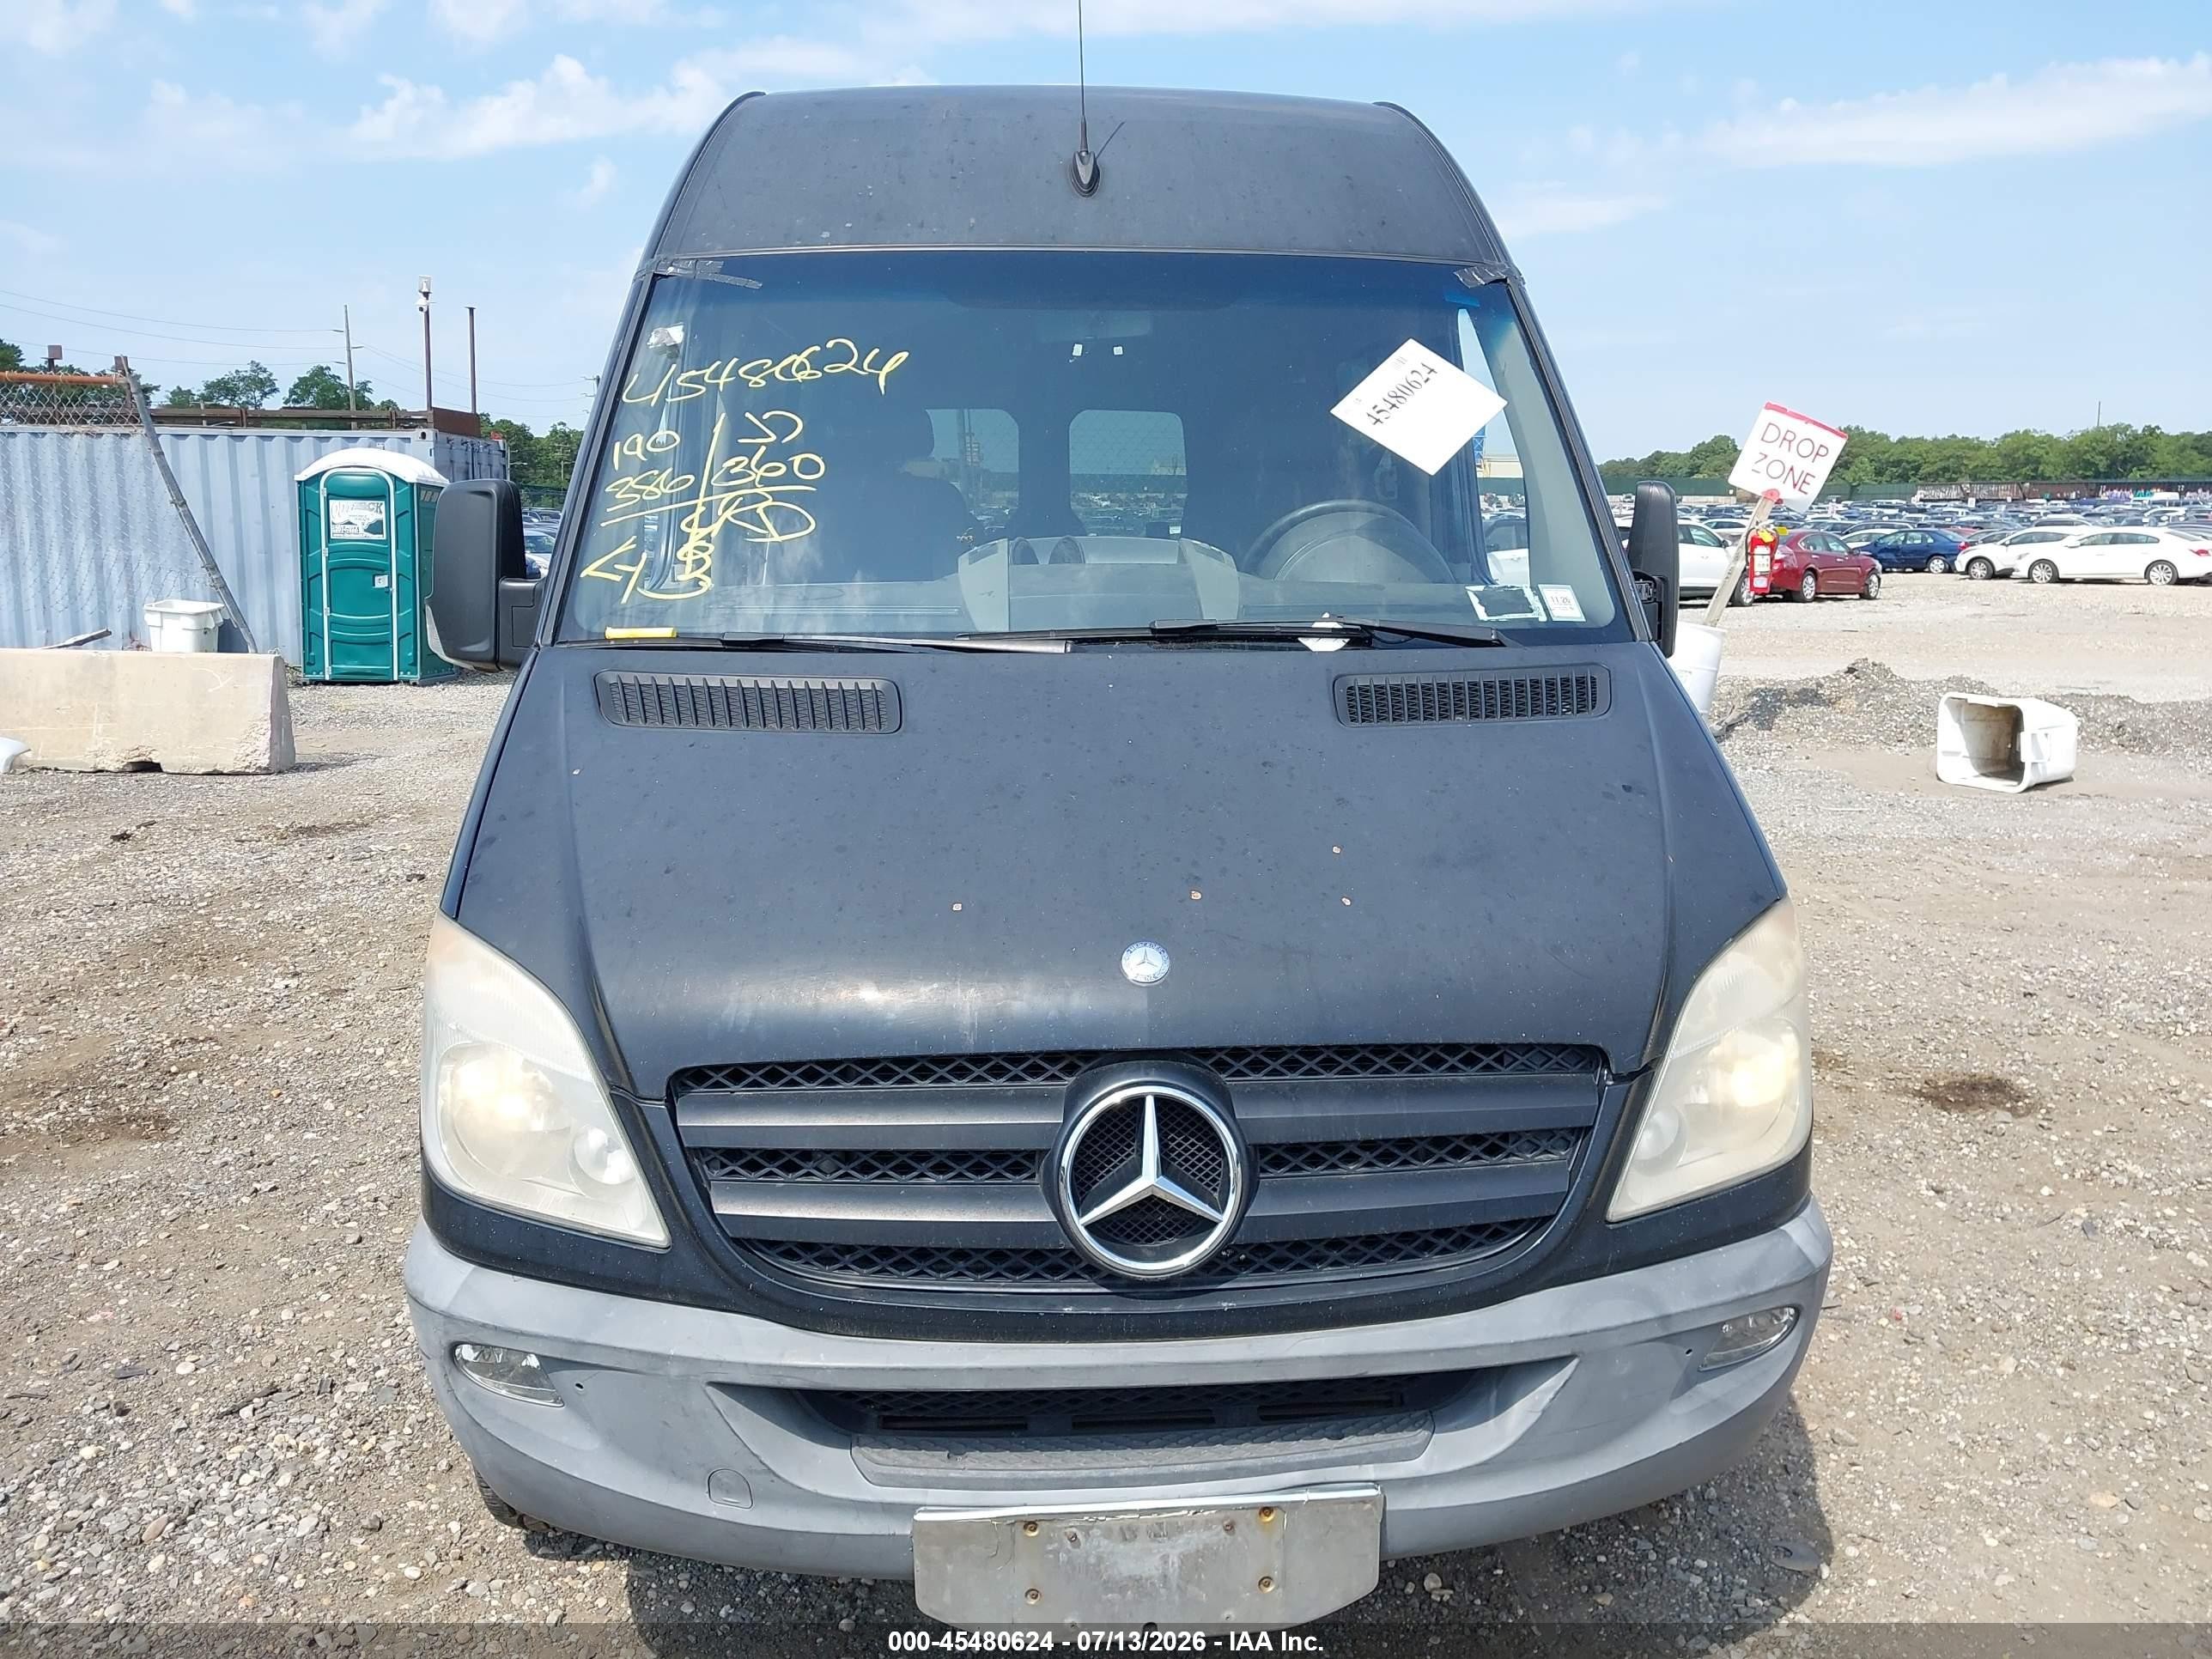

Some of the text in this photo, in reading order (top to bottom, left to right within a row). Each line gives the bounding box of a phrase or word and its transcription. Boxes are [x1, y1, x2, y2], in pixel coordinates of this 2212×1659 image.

[1366, 362, 1438, 425] 45480624
[1759, 422, 1829, 464] DROP
[1751, 452, 1816, 495] ZONE
